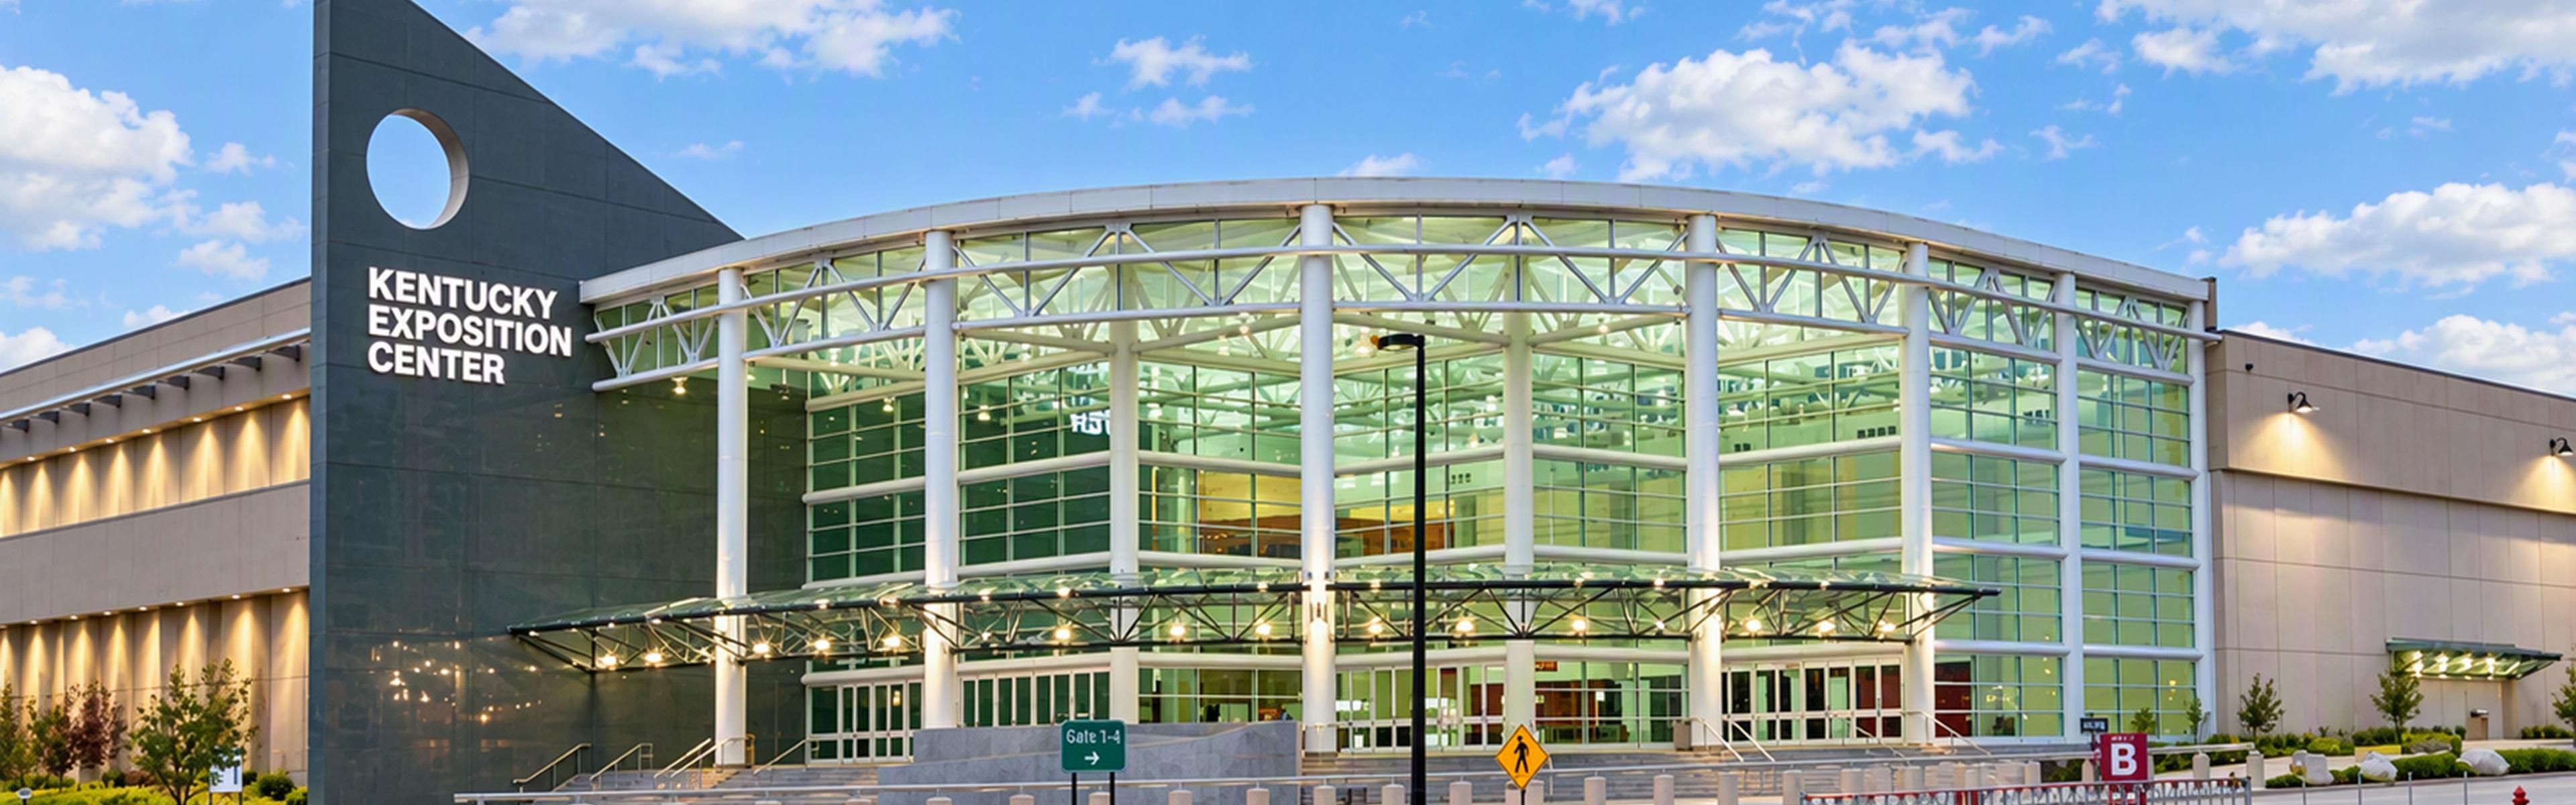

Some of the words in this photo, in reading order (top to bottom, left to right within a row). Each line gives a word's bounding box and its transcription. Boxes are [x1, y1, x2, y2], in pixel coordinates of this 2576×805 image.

[369, 266, 557, 319] KENTUCKY
[369, 303, 572, 357] EXPOSITION
[368, 341, 505, 384] CENTER
[1099, 729, 1121, 745] 1-4
[2110, 743, 2137, 776] B
